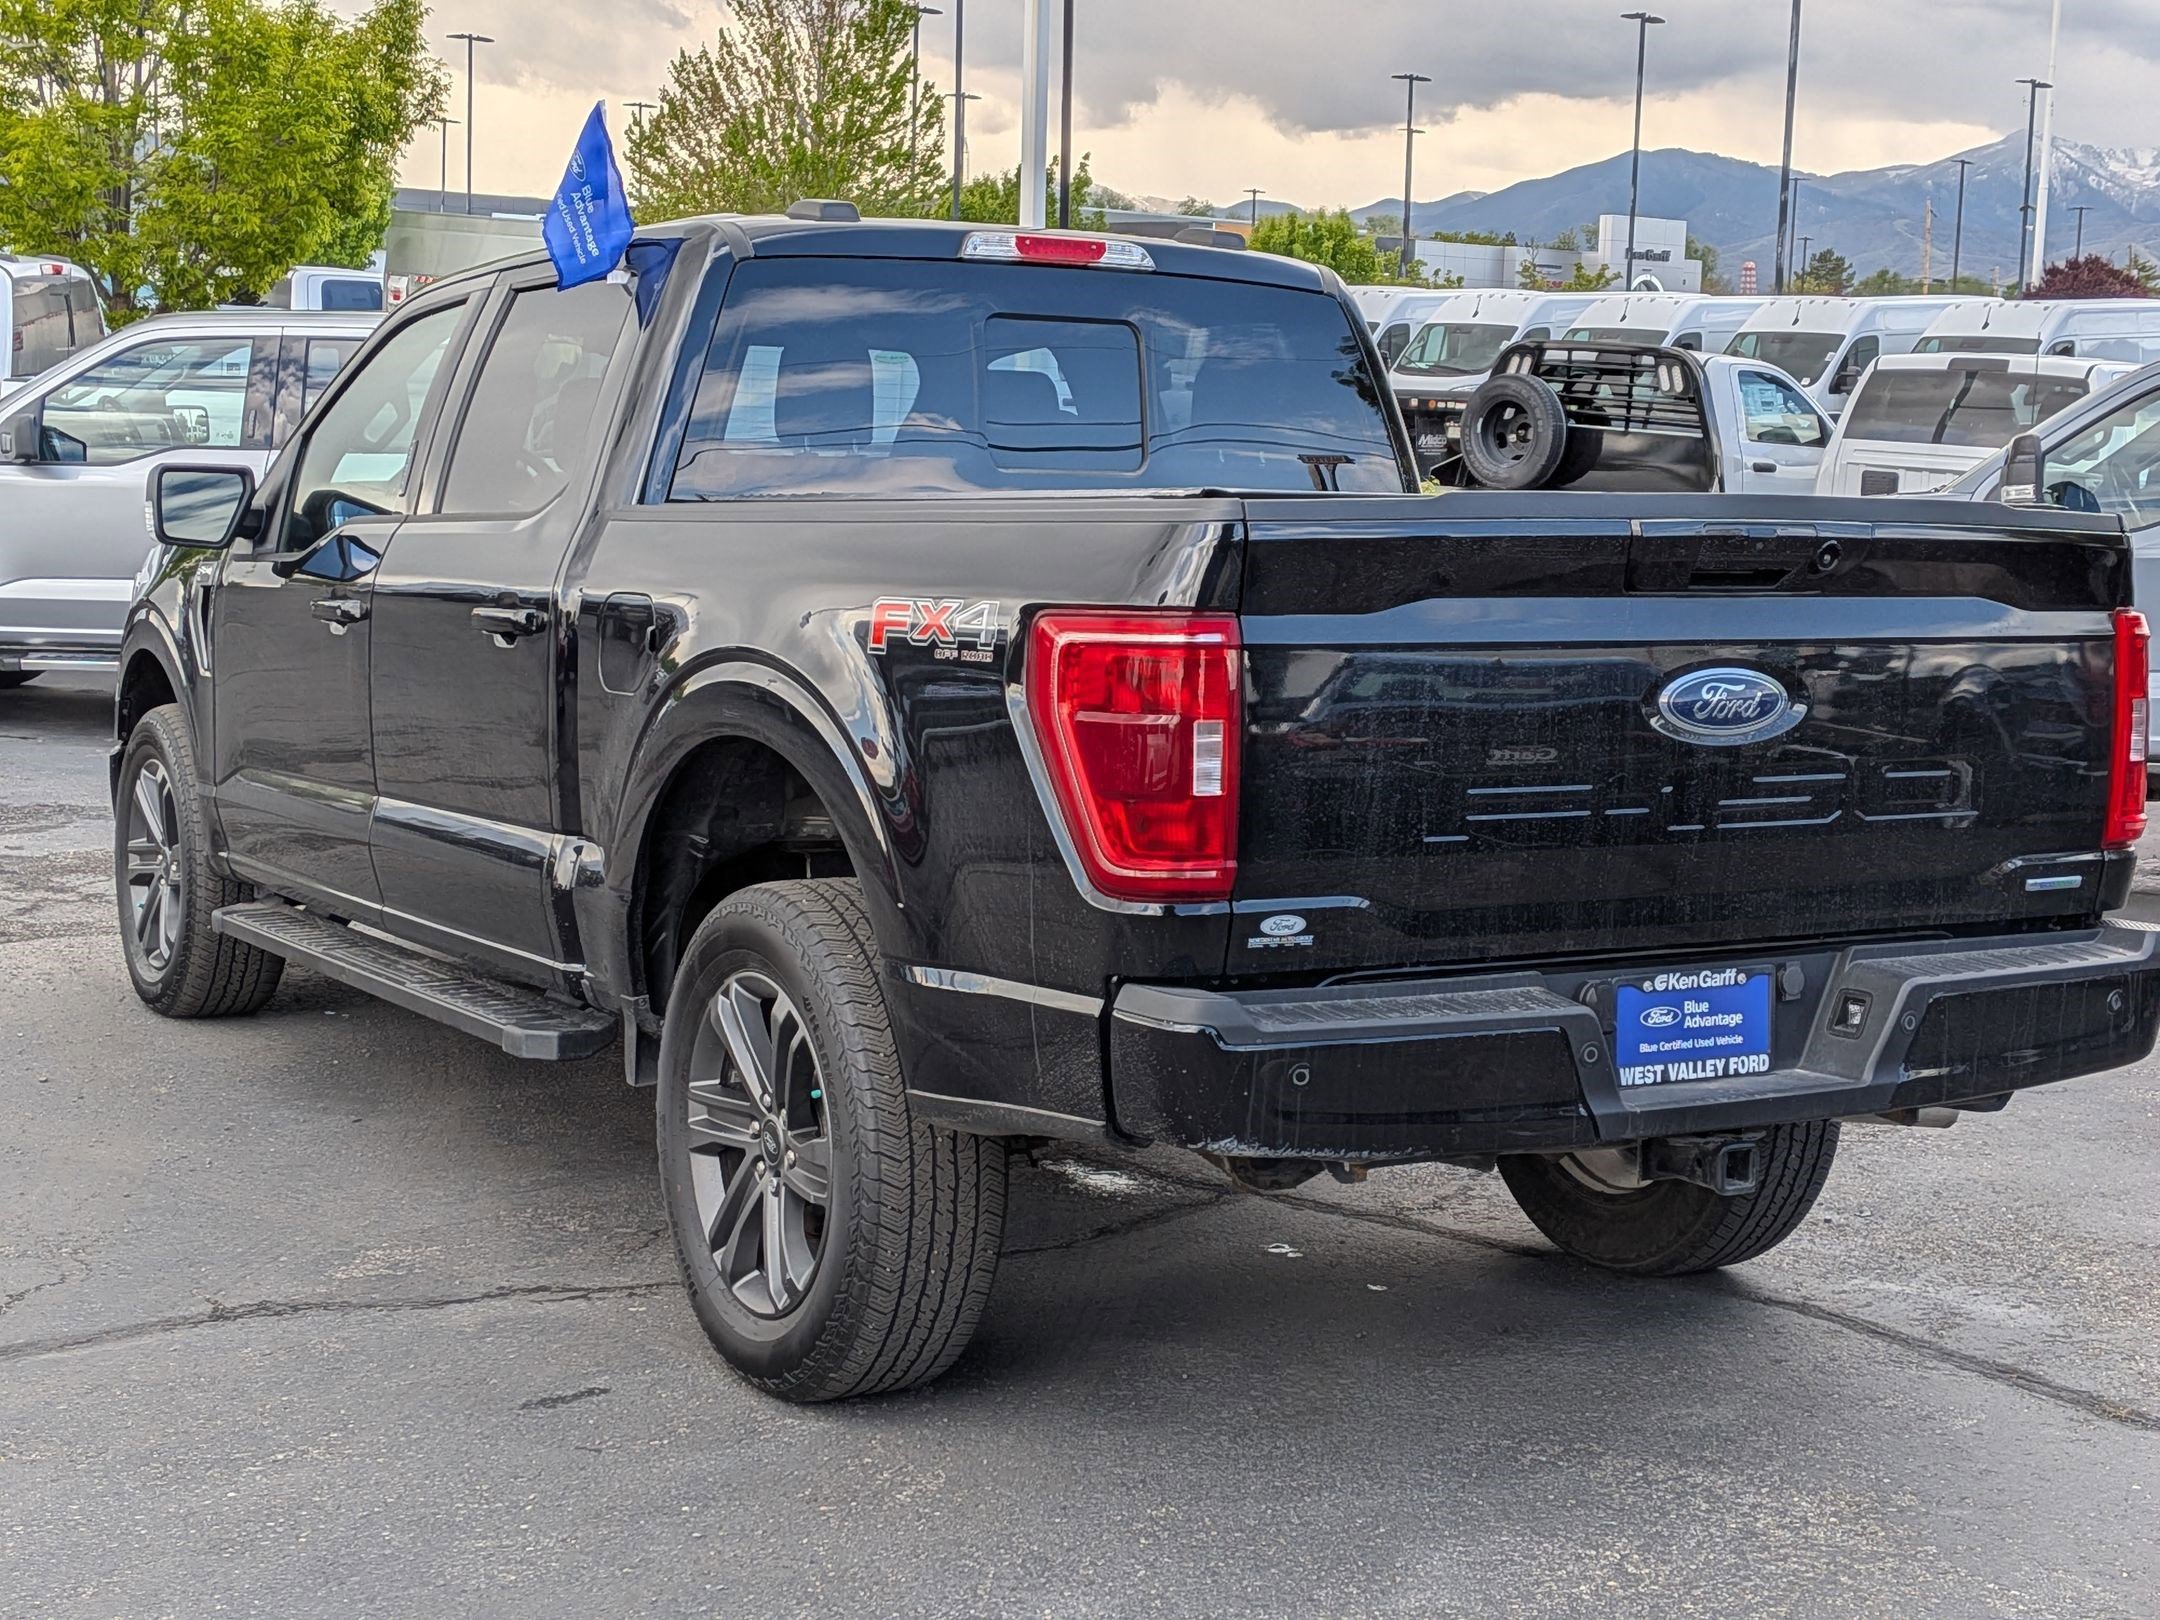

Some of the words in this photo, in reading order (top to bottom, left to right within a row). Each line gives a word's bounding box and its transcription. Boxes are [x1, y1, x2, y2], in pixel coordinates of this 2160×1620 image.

[582, 184, 594, 214] Blue
[562, 210, 576, 233] Used
[572, 232, 586, 265] Vehicle
[570, 193, 599, 256] Advantage
[867, 596, 1000, 655] FX4
[1693, 682, 1761, 719] Ford
[1668, 972, 1698, 991] Ken
[1699, 968, 1737, 988] Garff
[1647, 1009, 1674, 1024] Ford
[1683, 1000, 1709, 1014] Blue
[1683, 1013, 1743, 1029] Advantage
[1639, 1043, 1659, 1053] Blue
[1659, 1039, 1693, 1051] Certified
[1694, 1038, 1715, 1048] Used
[1716, 1034, 1744, 1045] Vehicle
[1619, 1064, 1665, 1086] WEST
[1667, 1058, 1726, 1082] VALLEY
[1728, 1053, 1770, 1075] FORD
